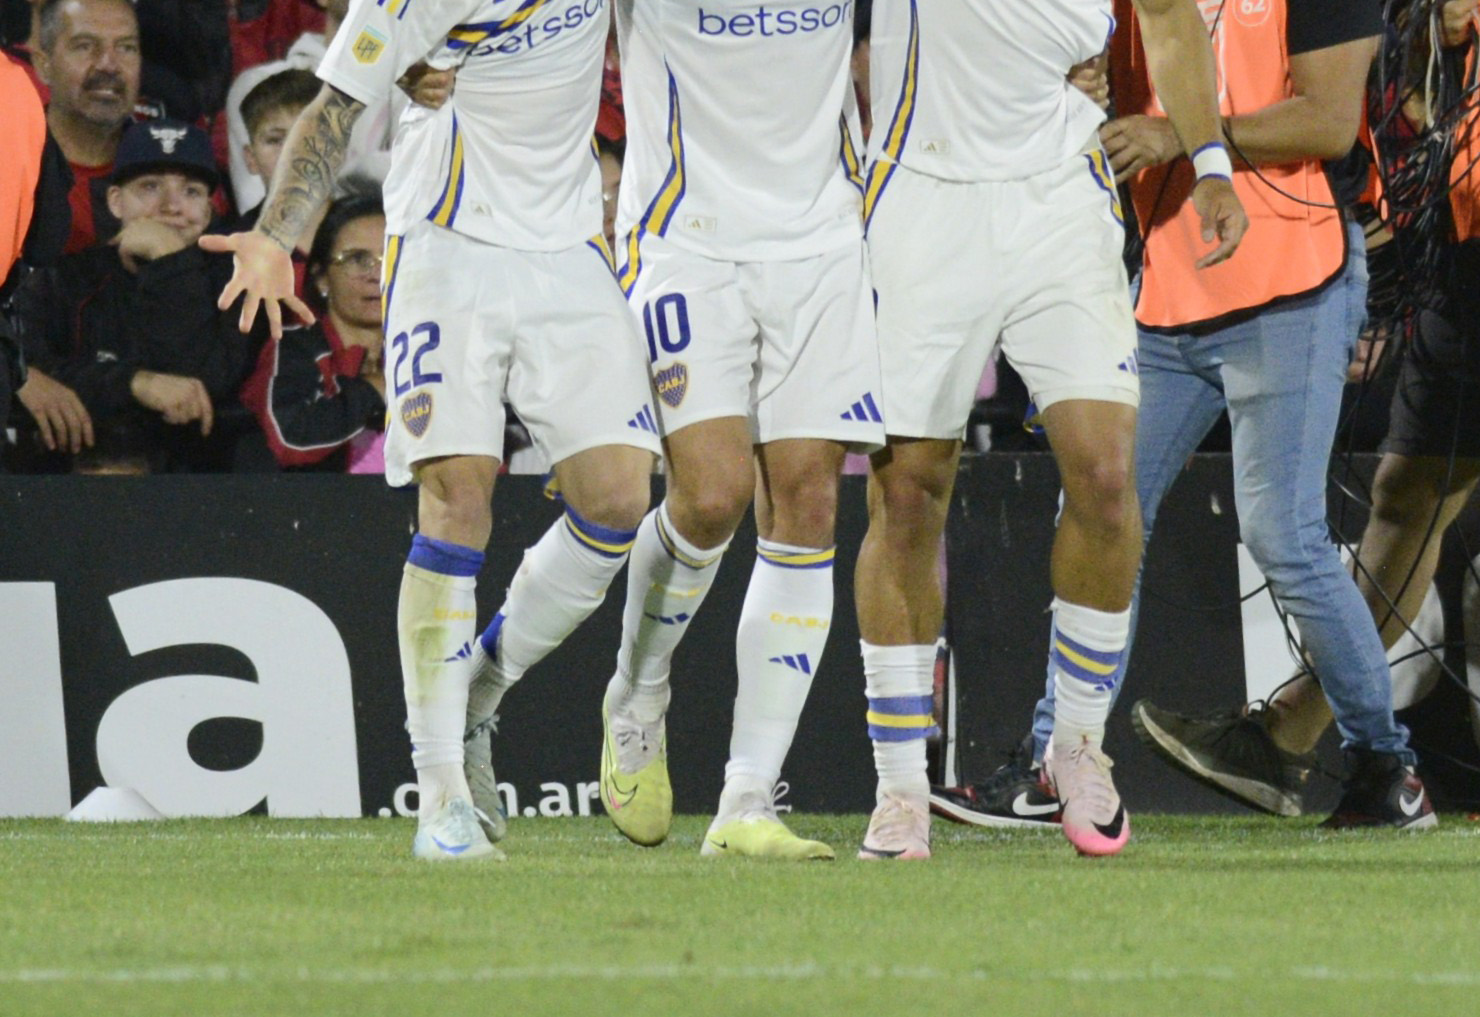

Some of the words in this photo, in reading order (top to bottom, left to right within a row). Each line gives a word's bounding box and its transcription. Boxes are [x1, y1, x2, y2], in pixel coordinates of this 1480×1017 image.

[643, 292, 691, 364] 10
[392, 321, 443, 397] 22
[657, 374, 686, 394] CABJ
[403, 404, 430, 422] CABJ
